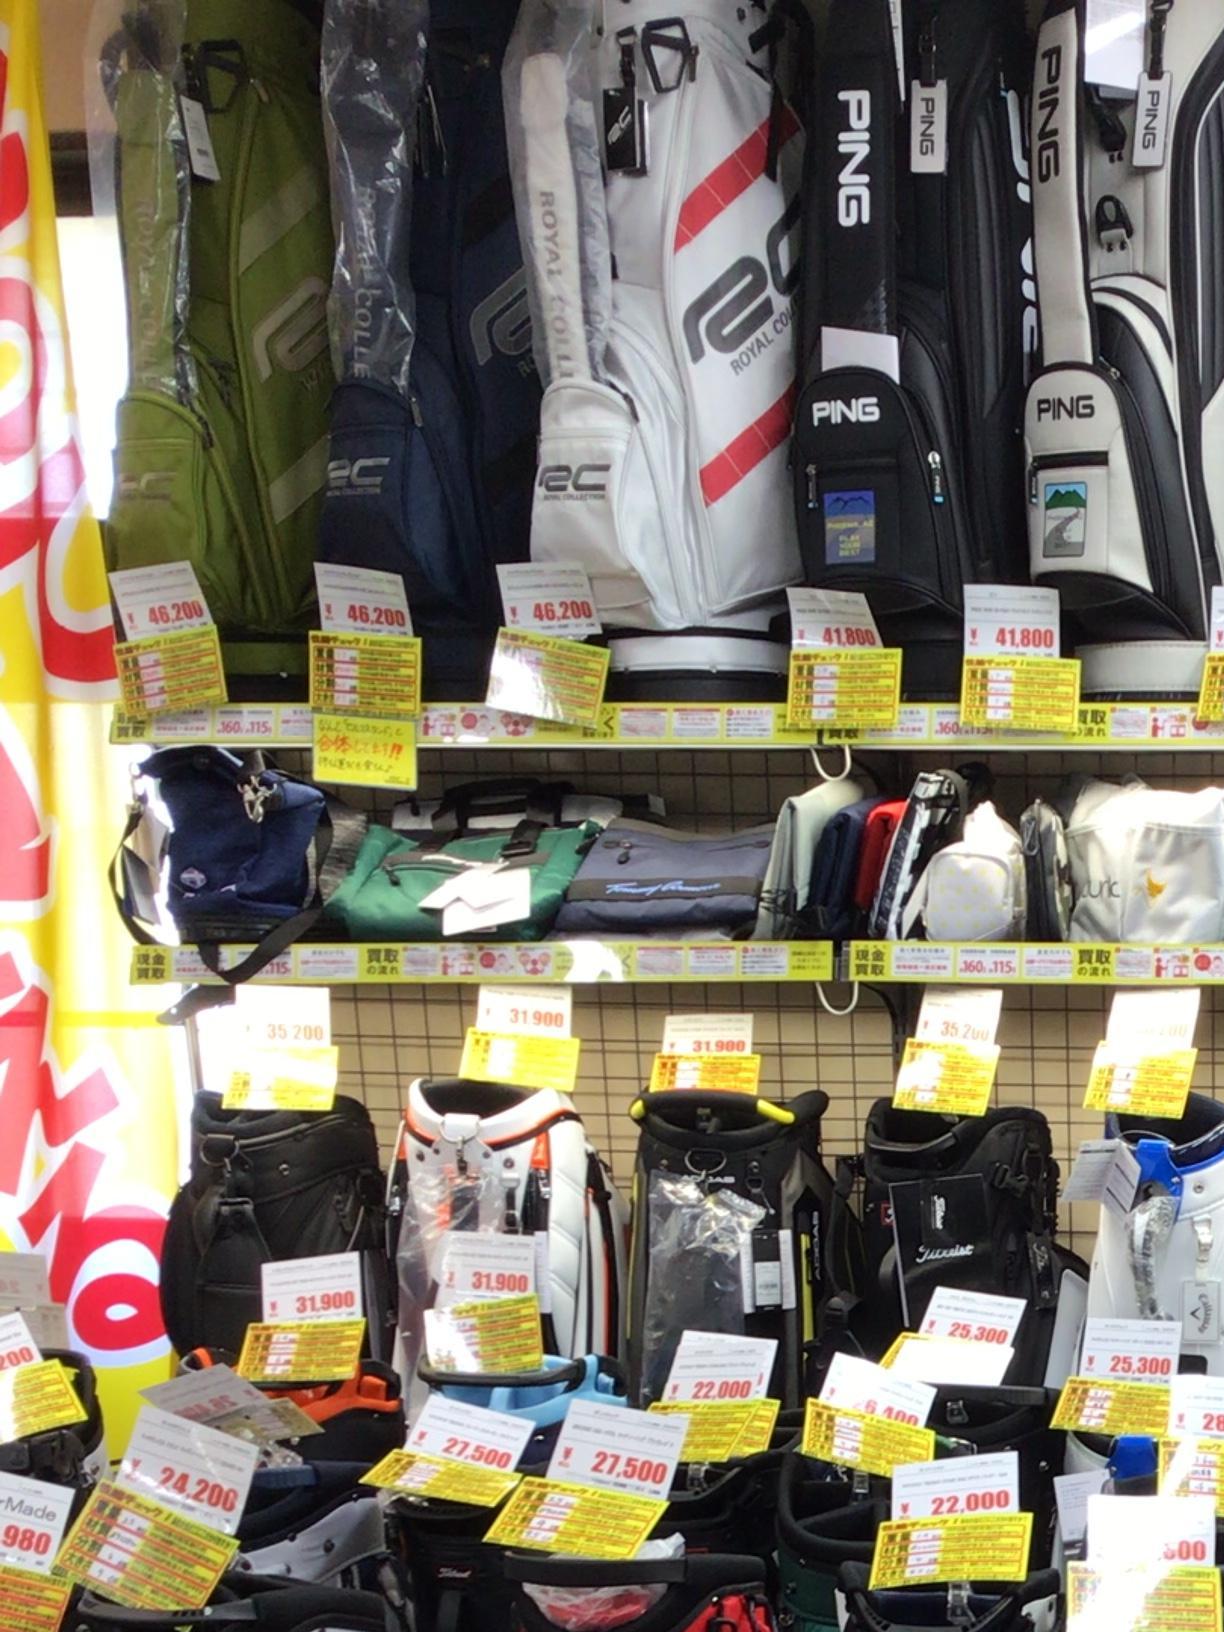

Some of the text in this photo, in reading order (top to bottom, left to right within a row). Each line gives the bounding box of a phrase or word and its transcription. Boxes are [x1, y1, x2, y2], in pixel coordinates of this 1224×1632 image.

[920, 96, 935, 156] PING
[1038, 45, 1064, 184] PING
[1141, 89, 1161, 151] PING
[836, 89, 871, 227] PING
[730, 331, 774, 376] ROYAL
[812, 396, 880, 427] PING
[1036, 394, 1095, 421] PING
[149, 601, 203, 625] 46,200
[348, 605, 405, 627] 46,200
[533, 601, 592, 622] 46,200
[823, 627, 875, 646] 41,800
[996, 628, 1054, 649] 41,800
[472, 1271, 529, 1292] 31,900
[295, 1290, 355, 1314] 31,900
[948, 1321, 1009, 1344] 25,300
[1109, 1355, 1171, 1376] 25,300
[691, 1379, 751, 1399] 22,000
[442, 1436, 512, 1469] 27,500
[590, 1450, 668, 1485] 27,500
[161, 1466, 239, 1513] 24,200
[931, 1490, 1010, 1515] 22,000
